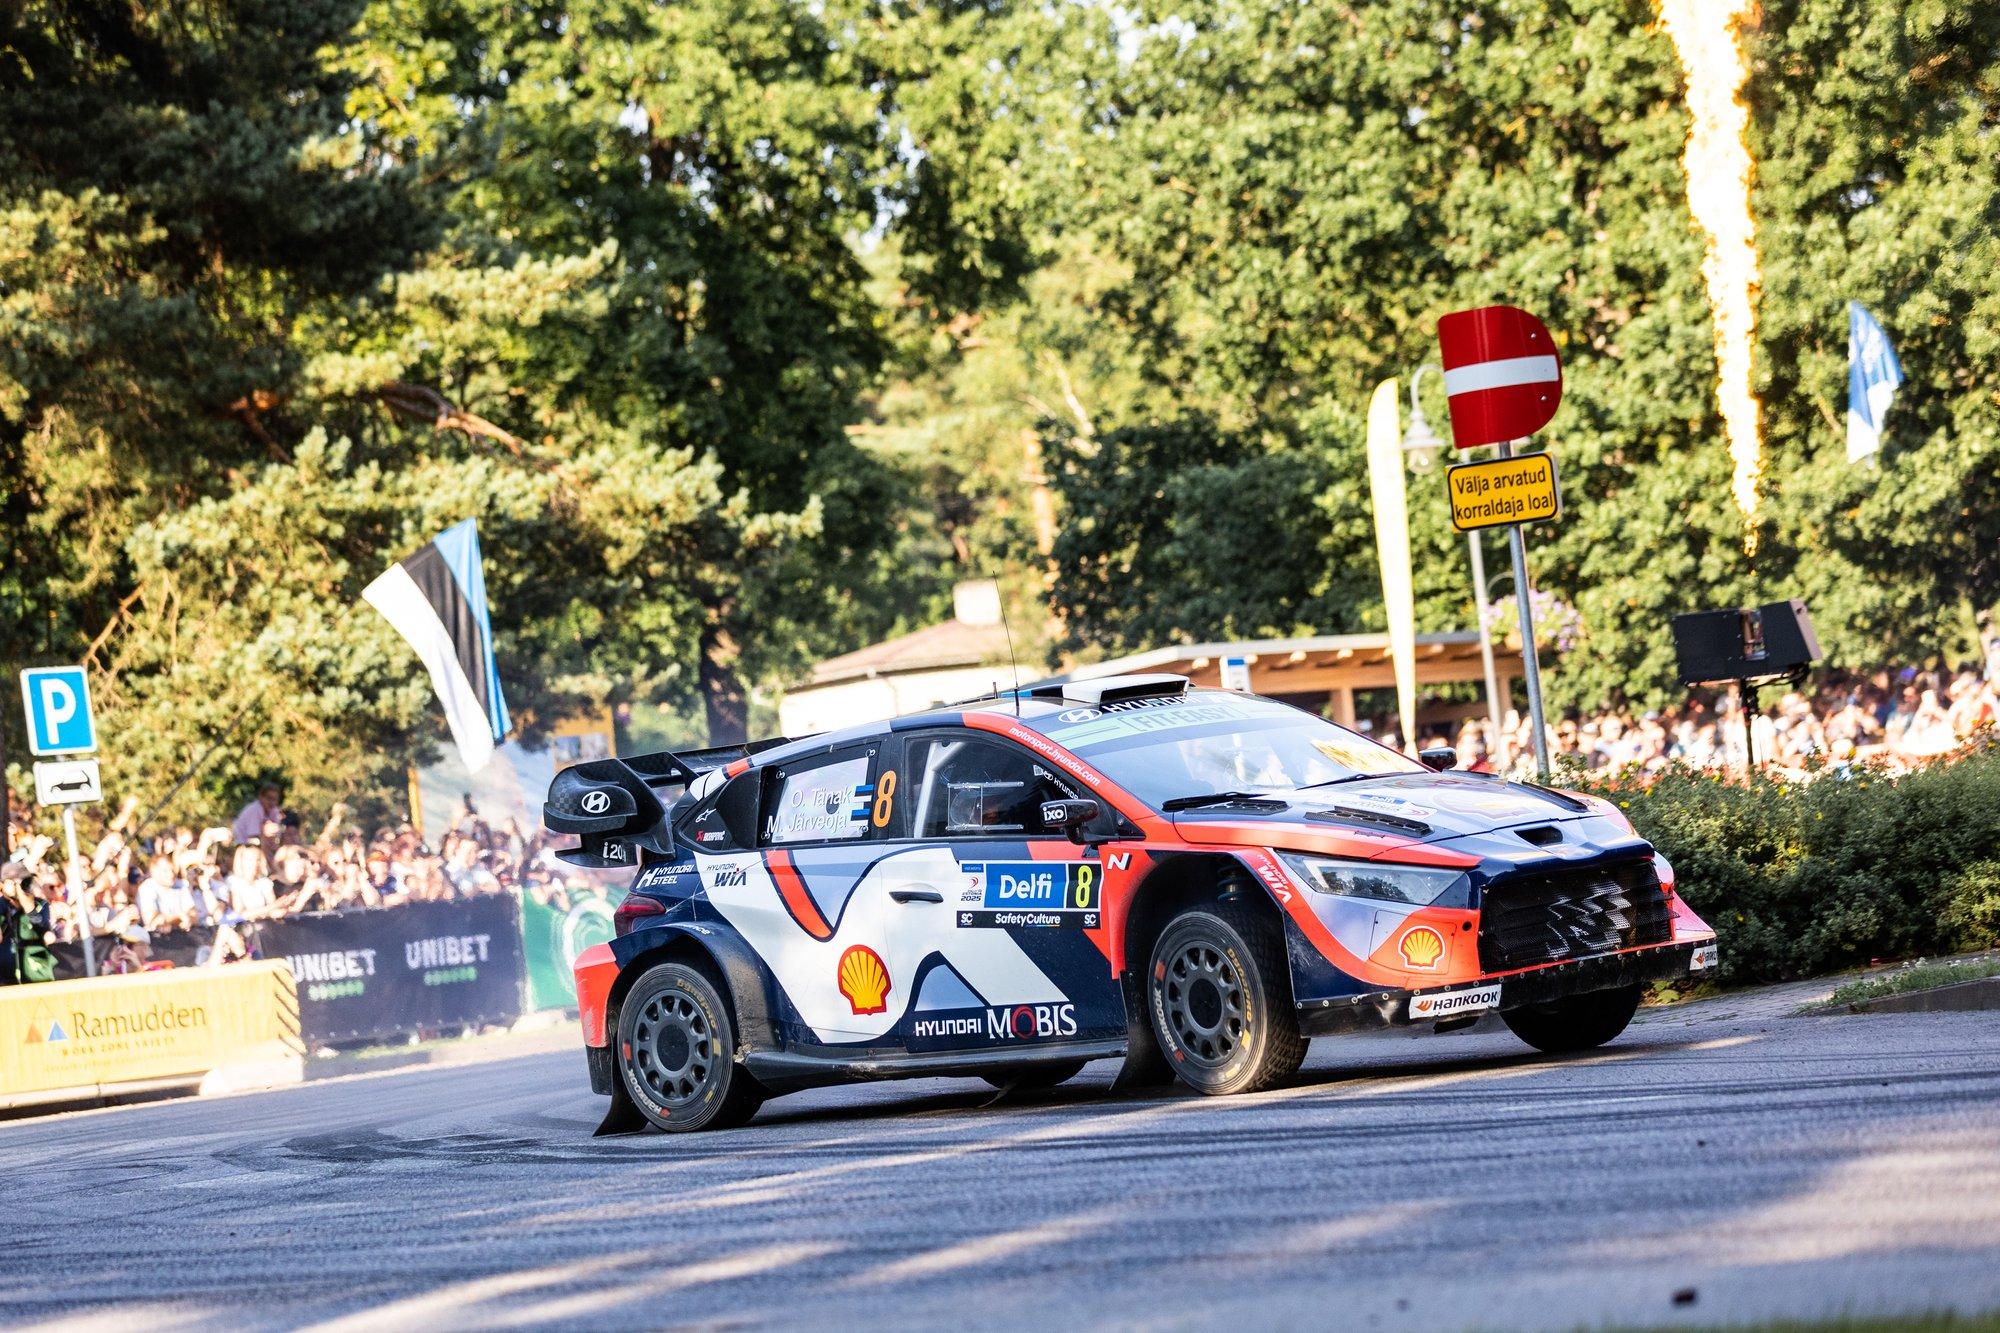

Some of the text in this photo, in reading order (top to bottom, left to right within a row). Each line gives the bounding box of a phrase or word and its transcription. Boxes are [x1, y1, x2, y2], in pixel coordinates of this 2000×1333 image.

[1455, 466, 1546, 496] Välja arvatud
[1455, 491, 1553, 520] korraldaja loal
[40, 678, 77, 745] P
[1008, 727, 1101, 787] motorsport.hyundai.com
[792, 787, 853, 808] O. Tänak
[873, 770, 897, 828] 8
[766, 810, 848, 833] M. Järveoja
[1043, 806, 1064, 821] ixo
[650, 875, 678, 885] STEEL
[657, 864, 695, 875] HYUNDAI
[706, 863, 737, 871] HYUNDAI
[999, 873, 1052, 899] Delfi
[1075, 865, 1093, 908] 8
[961, 913, 973, 924] SC
[995, 913, 1061, 926] SafetyCulture
[1084, 913, 1096, 925] SC
[286, 948, 377, 982] UNIBET
[405, 934, 490, 970] UNIBET
[72, 1002, 208, 1038] Ramudden
[915, 1004, 1078, 1040] HYUNDAI MOBIS
